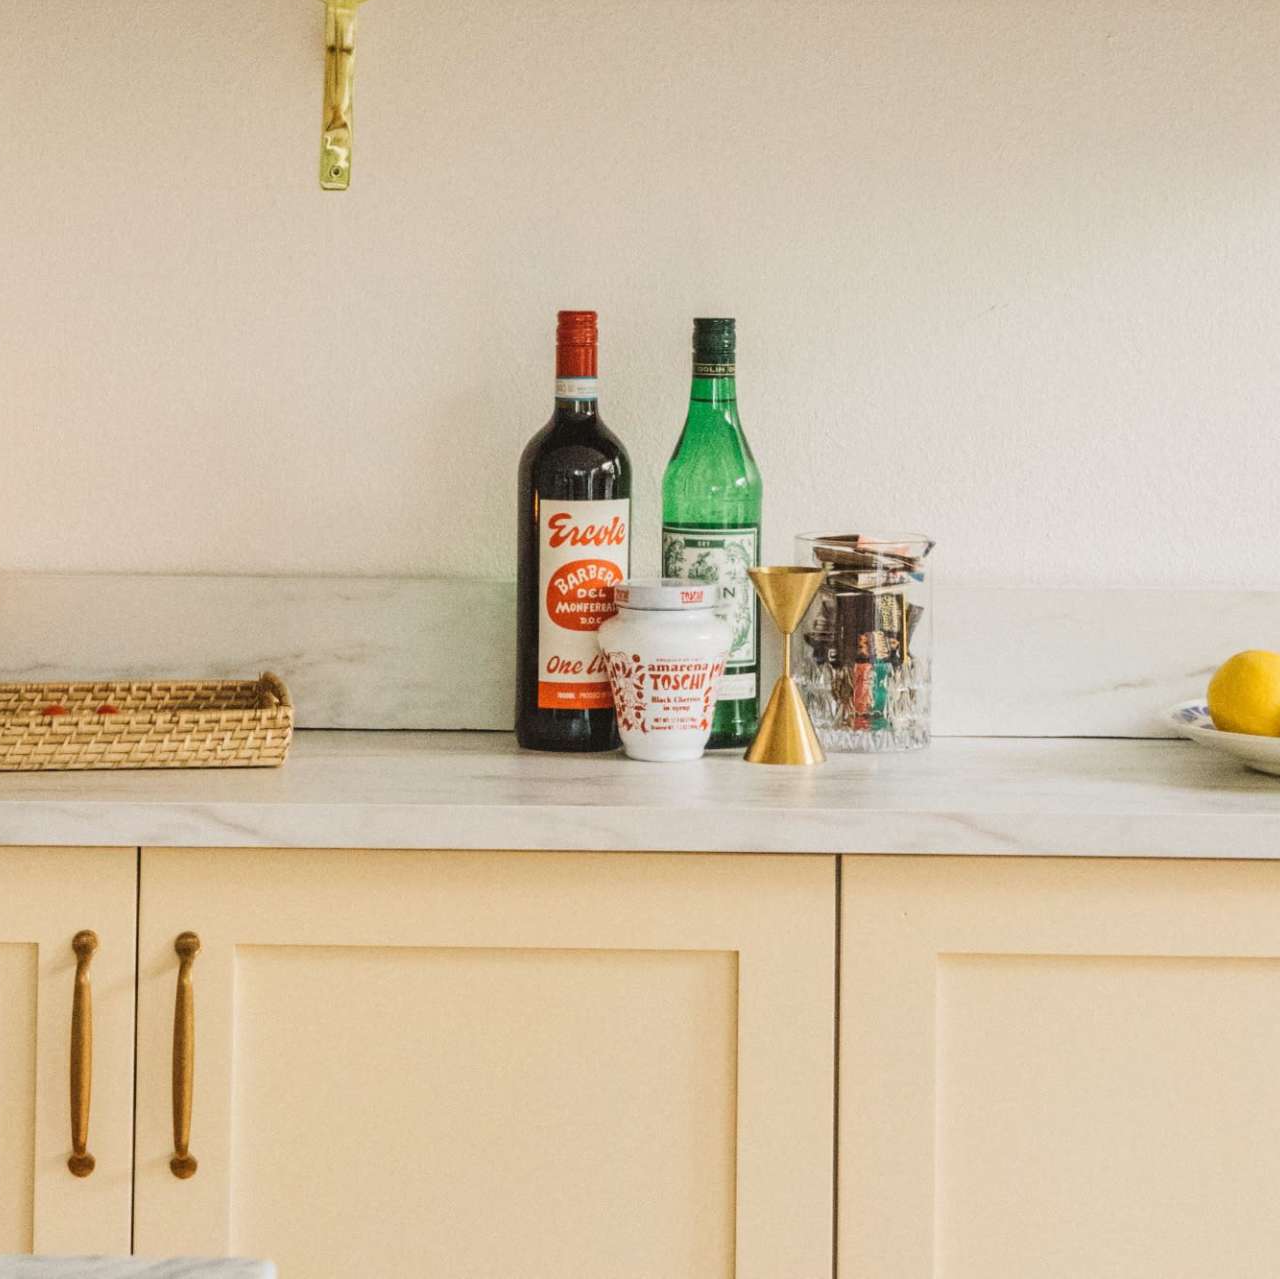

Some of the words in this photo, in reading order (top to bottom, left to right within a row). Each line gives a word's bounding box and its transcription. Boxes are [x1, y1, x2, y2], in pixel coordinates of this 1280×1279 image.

[548, 512, 625, 548] Ercole
[576, 587, 607, 599] DEL
[555, 601, 616, 614] MONFERRA
[546, 655, 583, 674] One
[647, 663, 708, 672] amarena
[649, 673, 706, 690] TOSCHI
